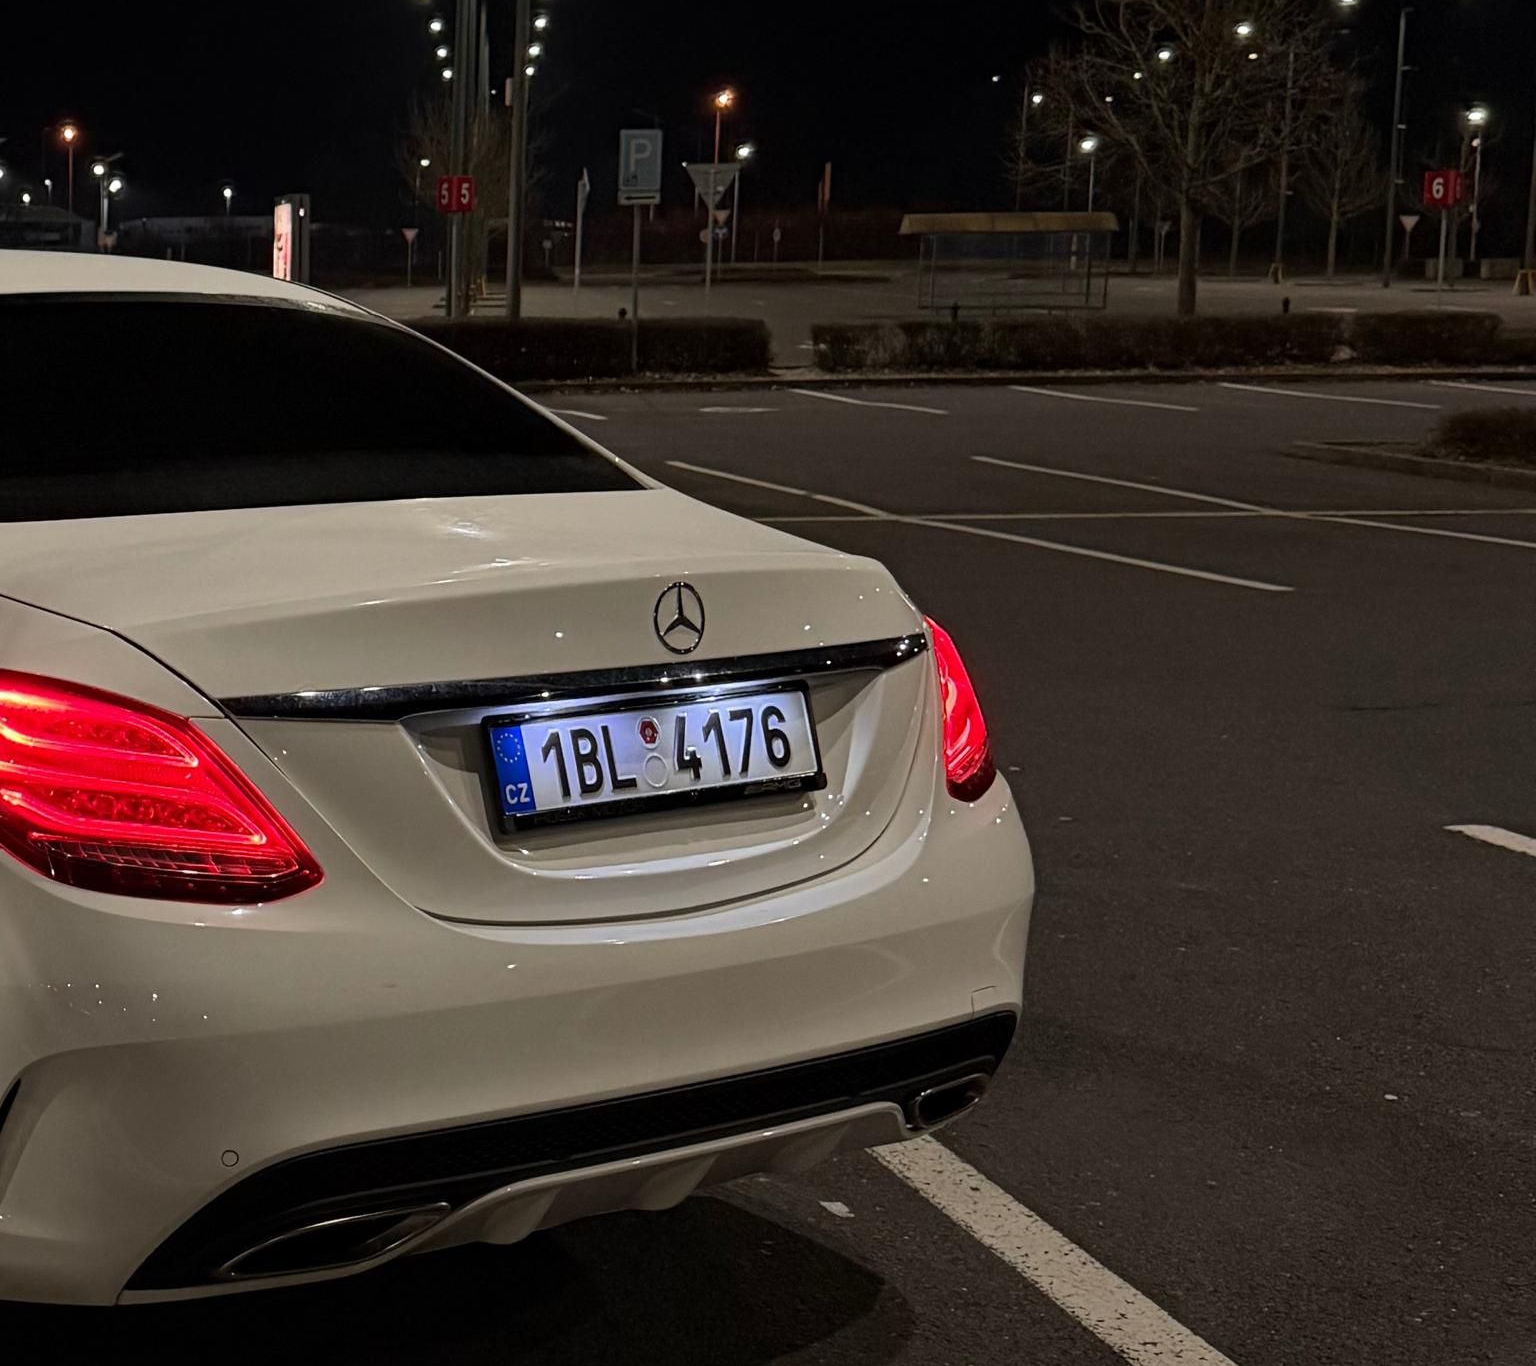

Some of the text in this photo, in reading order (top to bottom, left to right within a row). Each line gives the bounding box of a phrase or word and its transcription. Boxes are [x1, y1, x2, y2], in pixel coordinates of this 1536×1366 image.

[630, 138, 651, 172] P
[440, 182, 449, 206] 5
[460, 182, 470, 205] 5
[1432, 177, 1444, 200] 6
[541, 705, 791, 801] 1BL 4176
[505, 784, 530, 805] CZ
